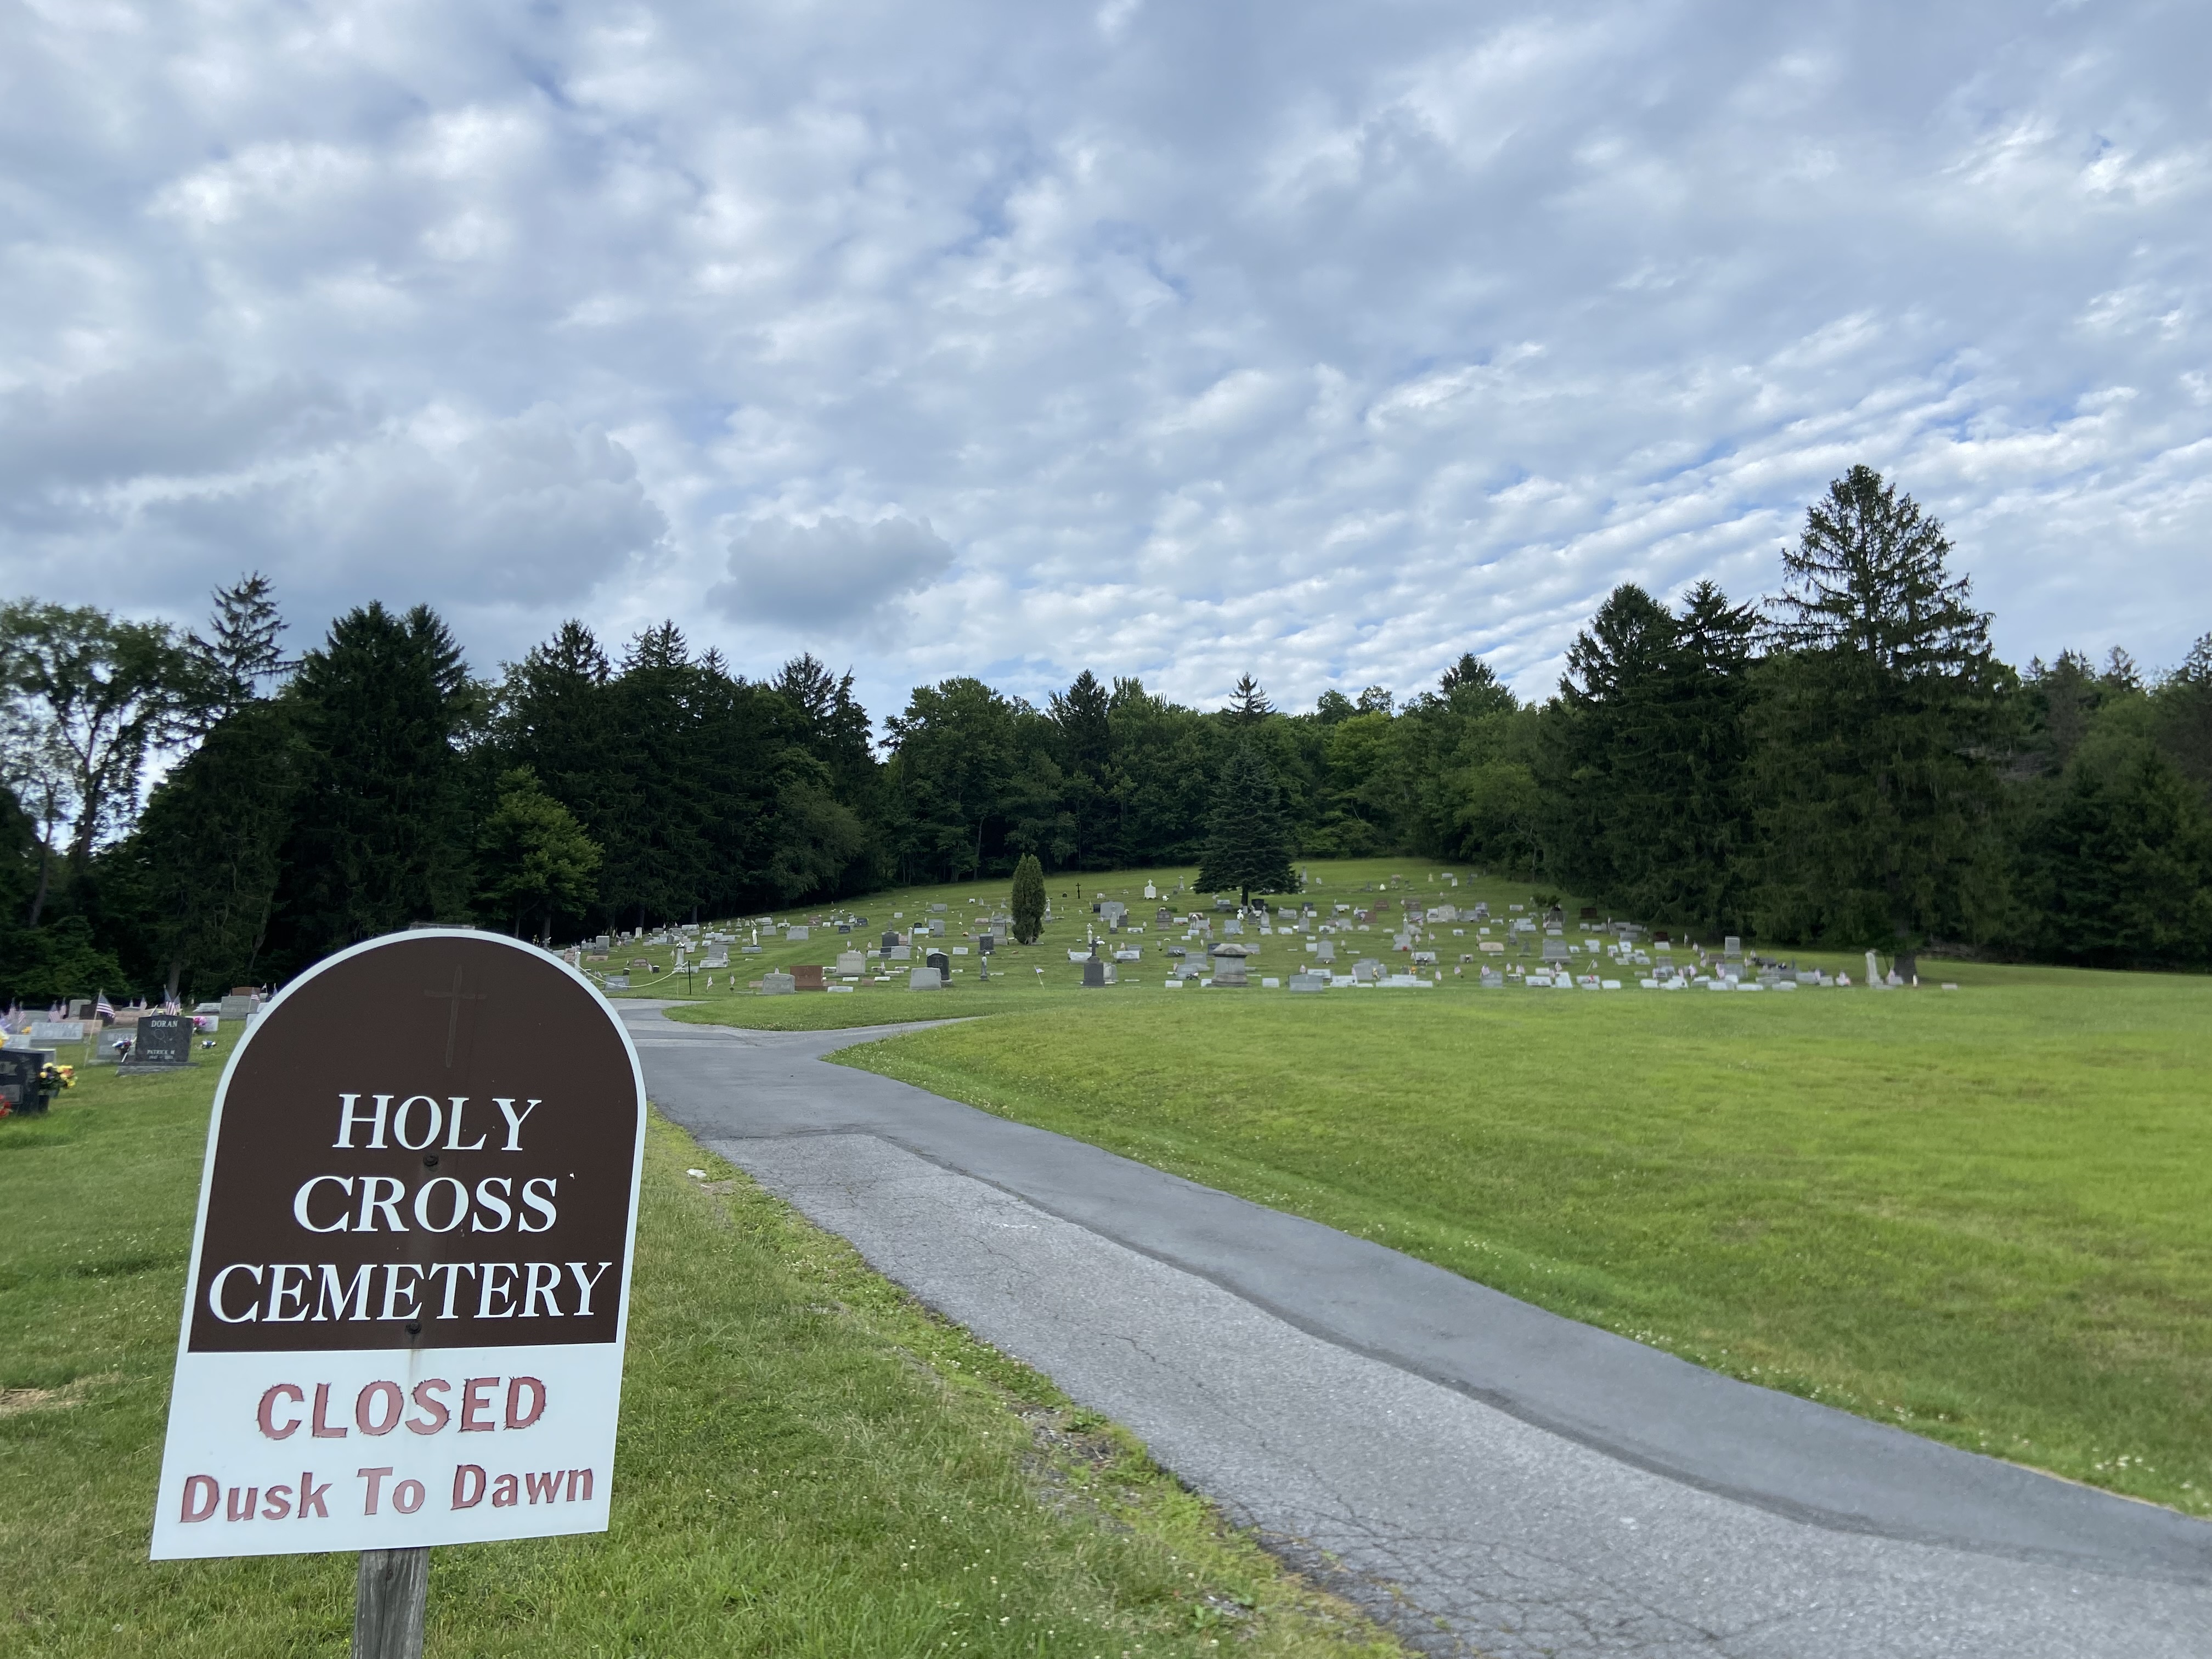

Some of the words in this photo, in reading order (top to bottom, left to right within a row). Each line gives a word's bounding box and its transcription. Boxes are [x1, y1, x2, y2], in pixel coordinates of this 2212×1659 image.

[332, 1093, 542, 1151] HOLY
[293, 1175, 557, 1233] CROSS
[209, 1262, 612, 1323] CEMETERY
[257, 1376, 546, 1440] CLOSED
[179, 1472, 332, 1523] Dusk
[357, 1467, 425, 1515] To
[451, 1464, 594, 1511] Dawn
